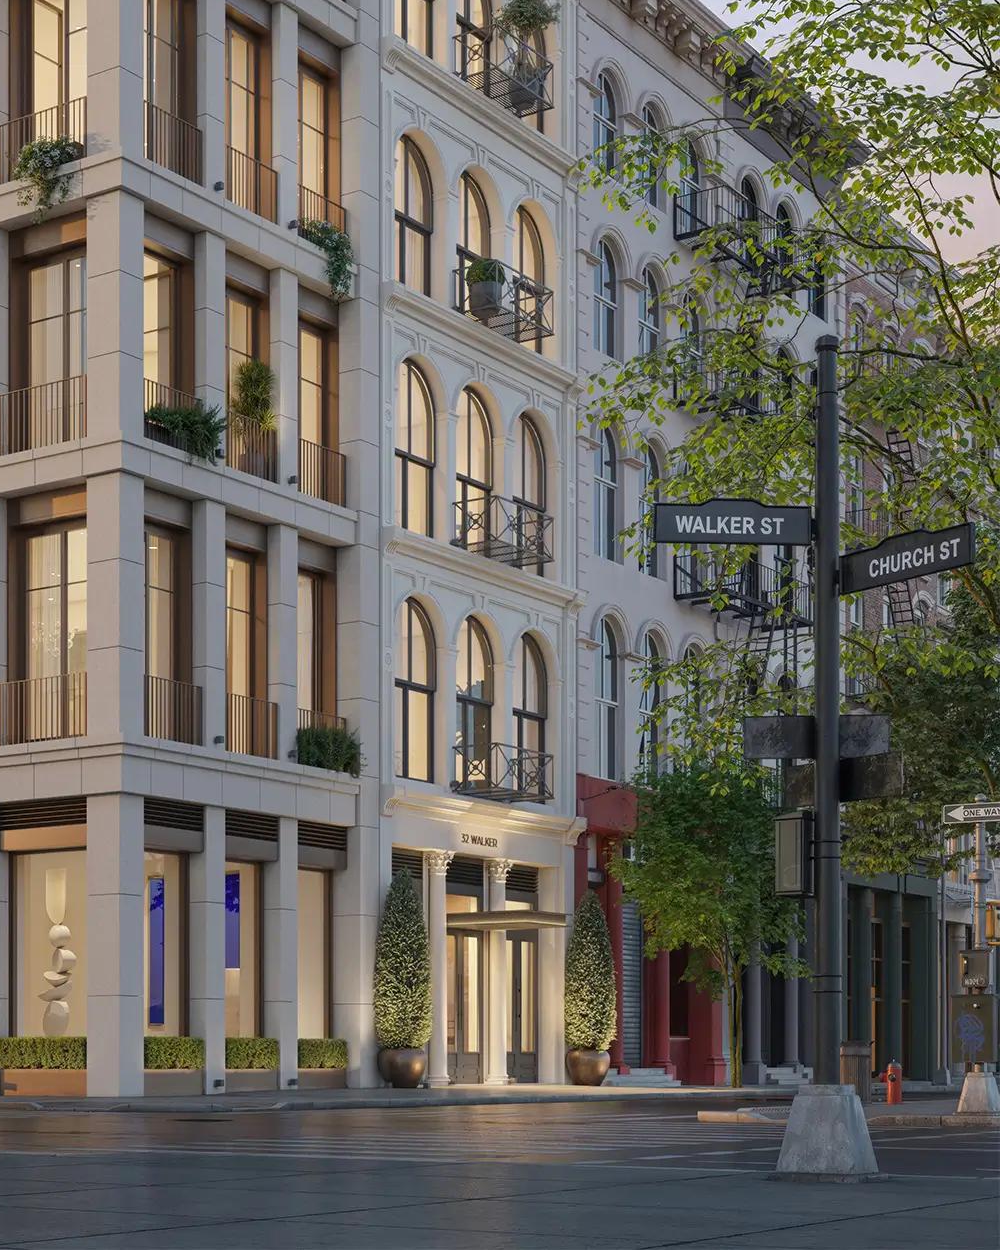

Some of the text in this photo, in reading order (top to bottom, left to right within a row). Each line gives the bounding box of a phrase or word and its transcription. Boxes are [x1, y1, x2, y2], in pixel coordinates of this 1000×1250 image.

[675, 515, 784, 535] WALKER ST
[869, 538, 961, 578] CHURCH ST
[963, 809, 982, 817] ONE
[461, 833, 498, 848] 32 WALKER
